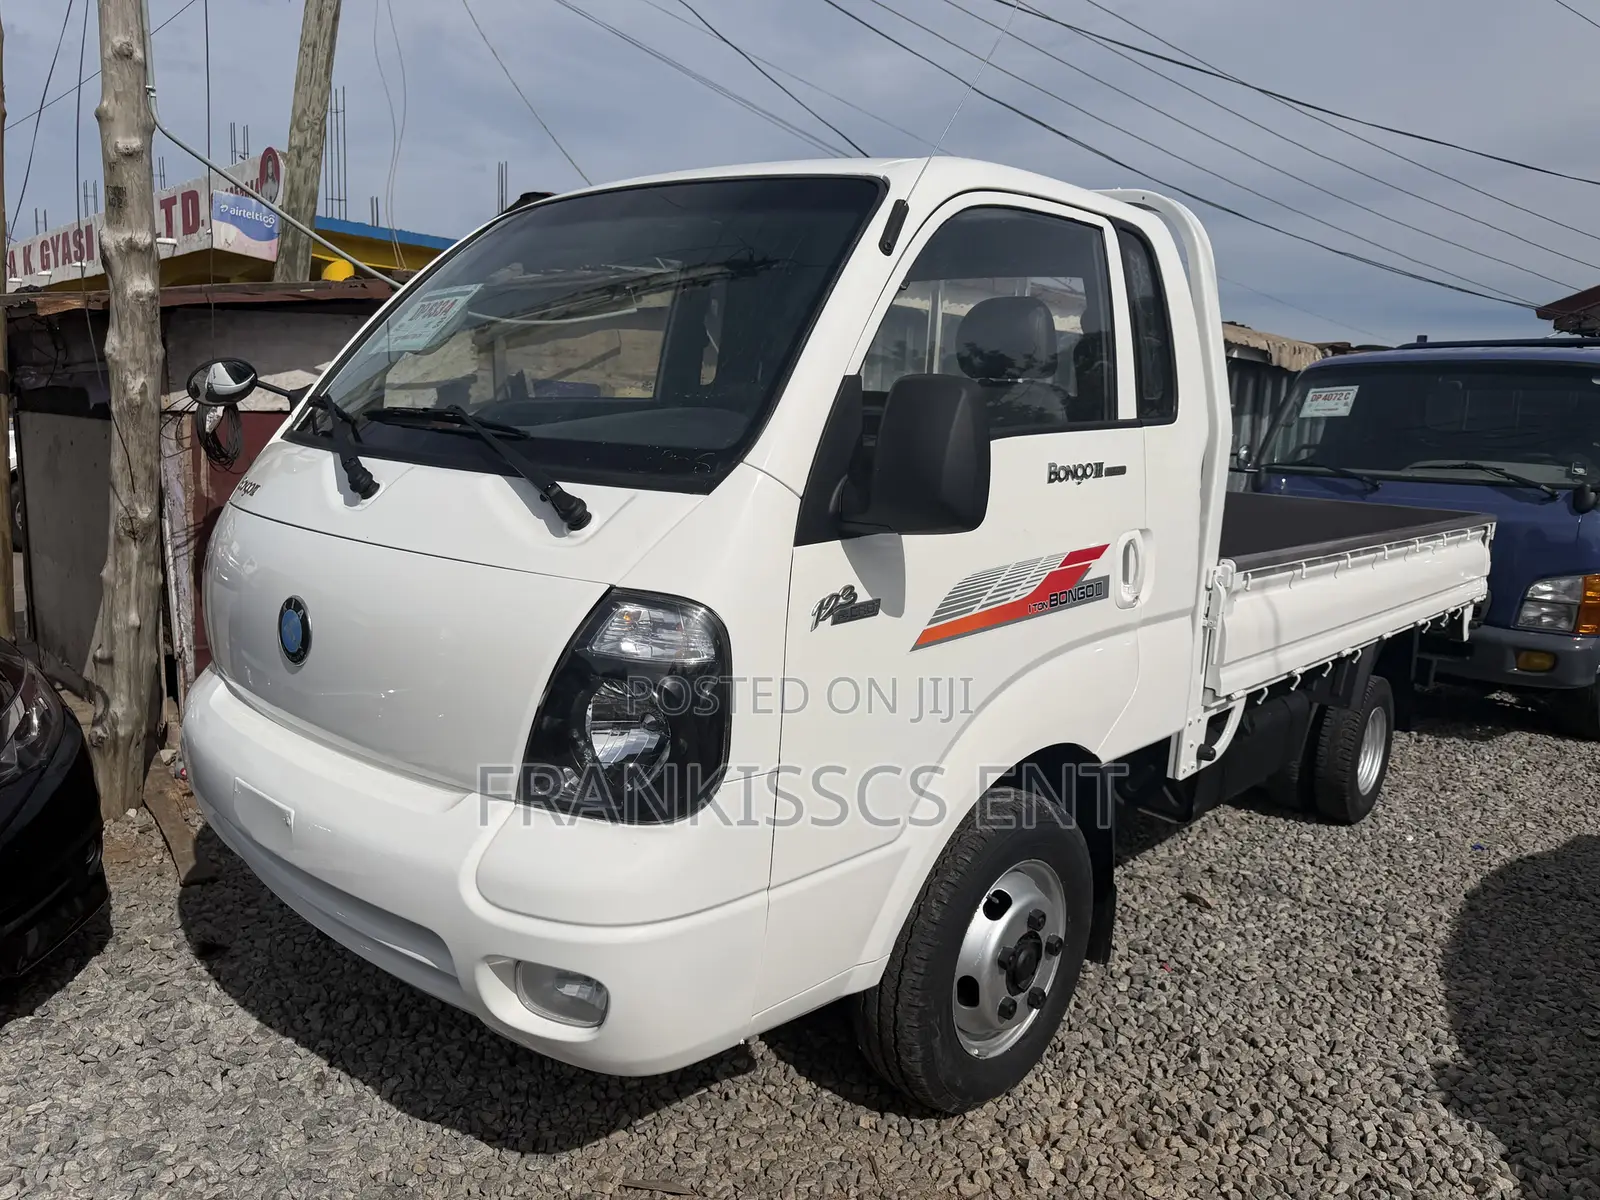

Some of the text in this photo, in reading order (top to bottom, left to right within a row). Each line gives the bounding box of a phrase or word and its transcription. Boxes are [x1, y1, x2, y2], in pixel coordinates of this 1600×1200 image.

[39, 223, 95, 271] GYASI
[154, 189, 205, 239] TD.
[229, 205, 275, 228] airteltigo
[1032, 601, 1048, 612] TON
[1048, 583, 1095, 608] BONGO
